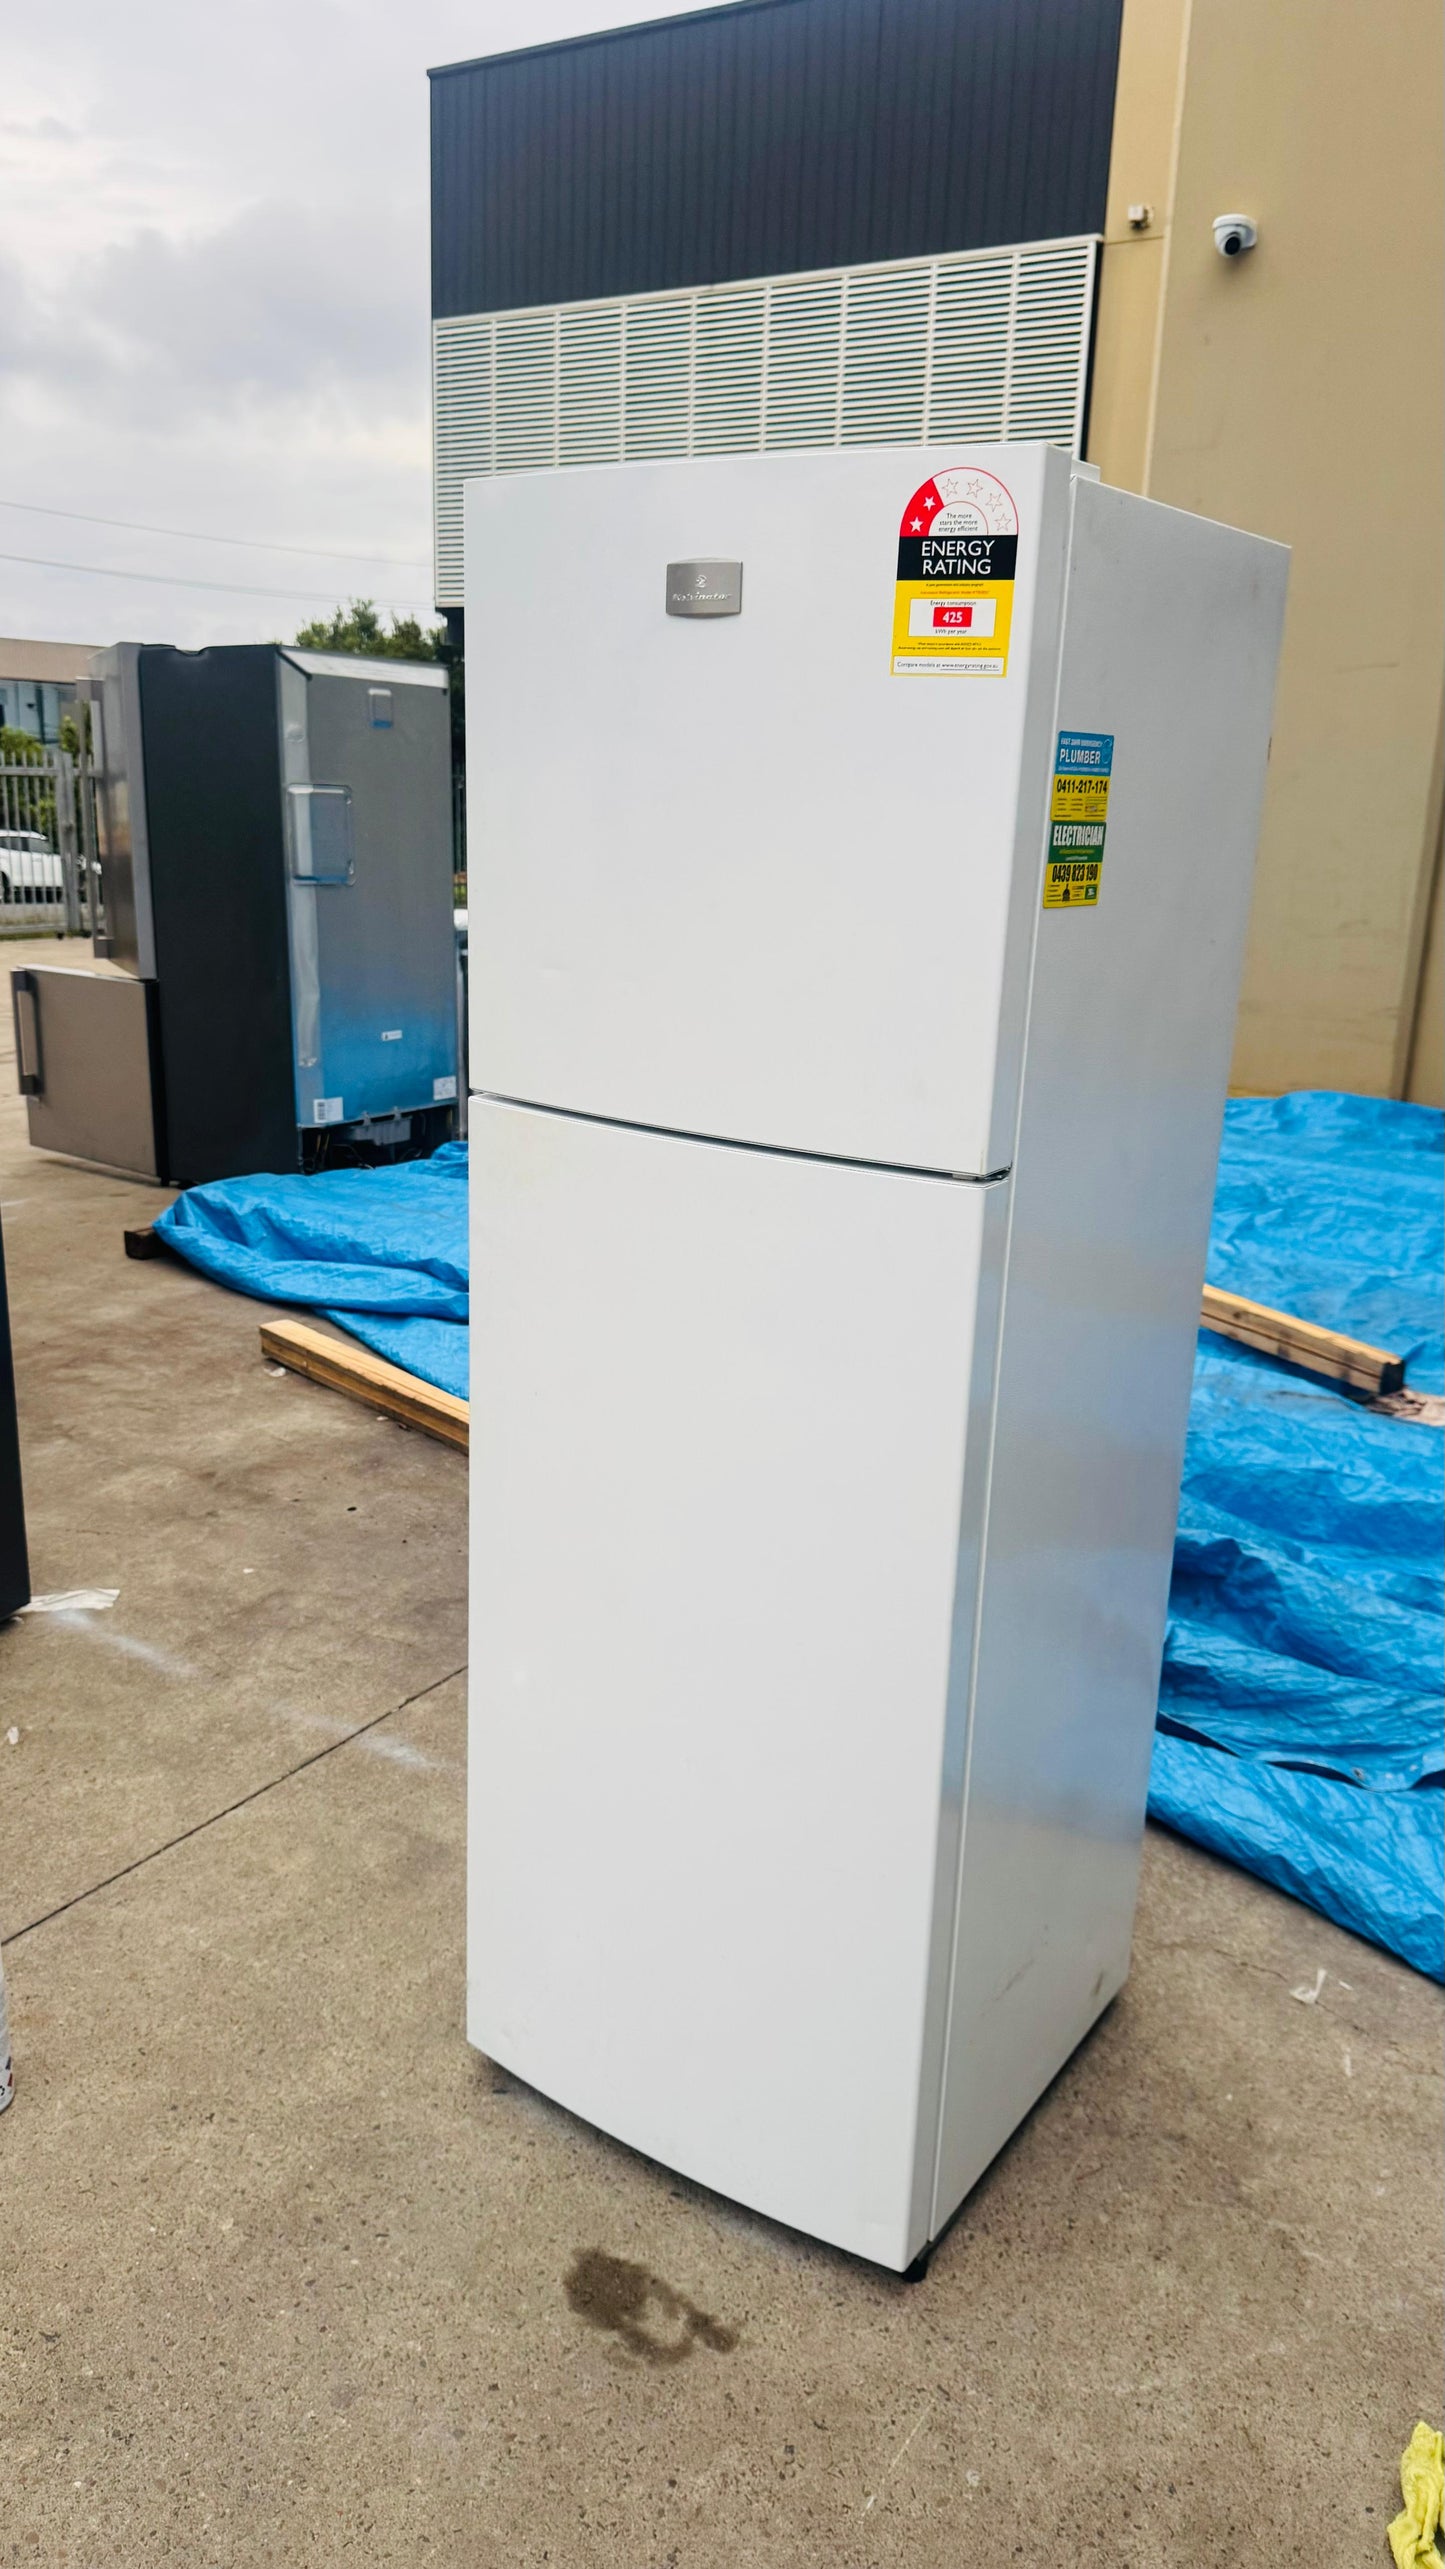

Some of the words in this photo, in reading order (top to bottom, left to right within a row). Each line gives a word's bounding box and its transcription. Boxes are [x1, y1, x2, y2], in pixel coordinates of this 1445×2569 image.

[921, 540, 995, 556] ENERGY
[922, 559, 991, 575] RATING
[942, 612, 963, 623] 425
[1060, 748, 1100, 764] PLUMBER
[1057, 779, 1107, 794] 0411-217-174
[1053, 825, 1104, 846] ELECTRICIAN
[1052, 864, 1071, 883] 0439
